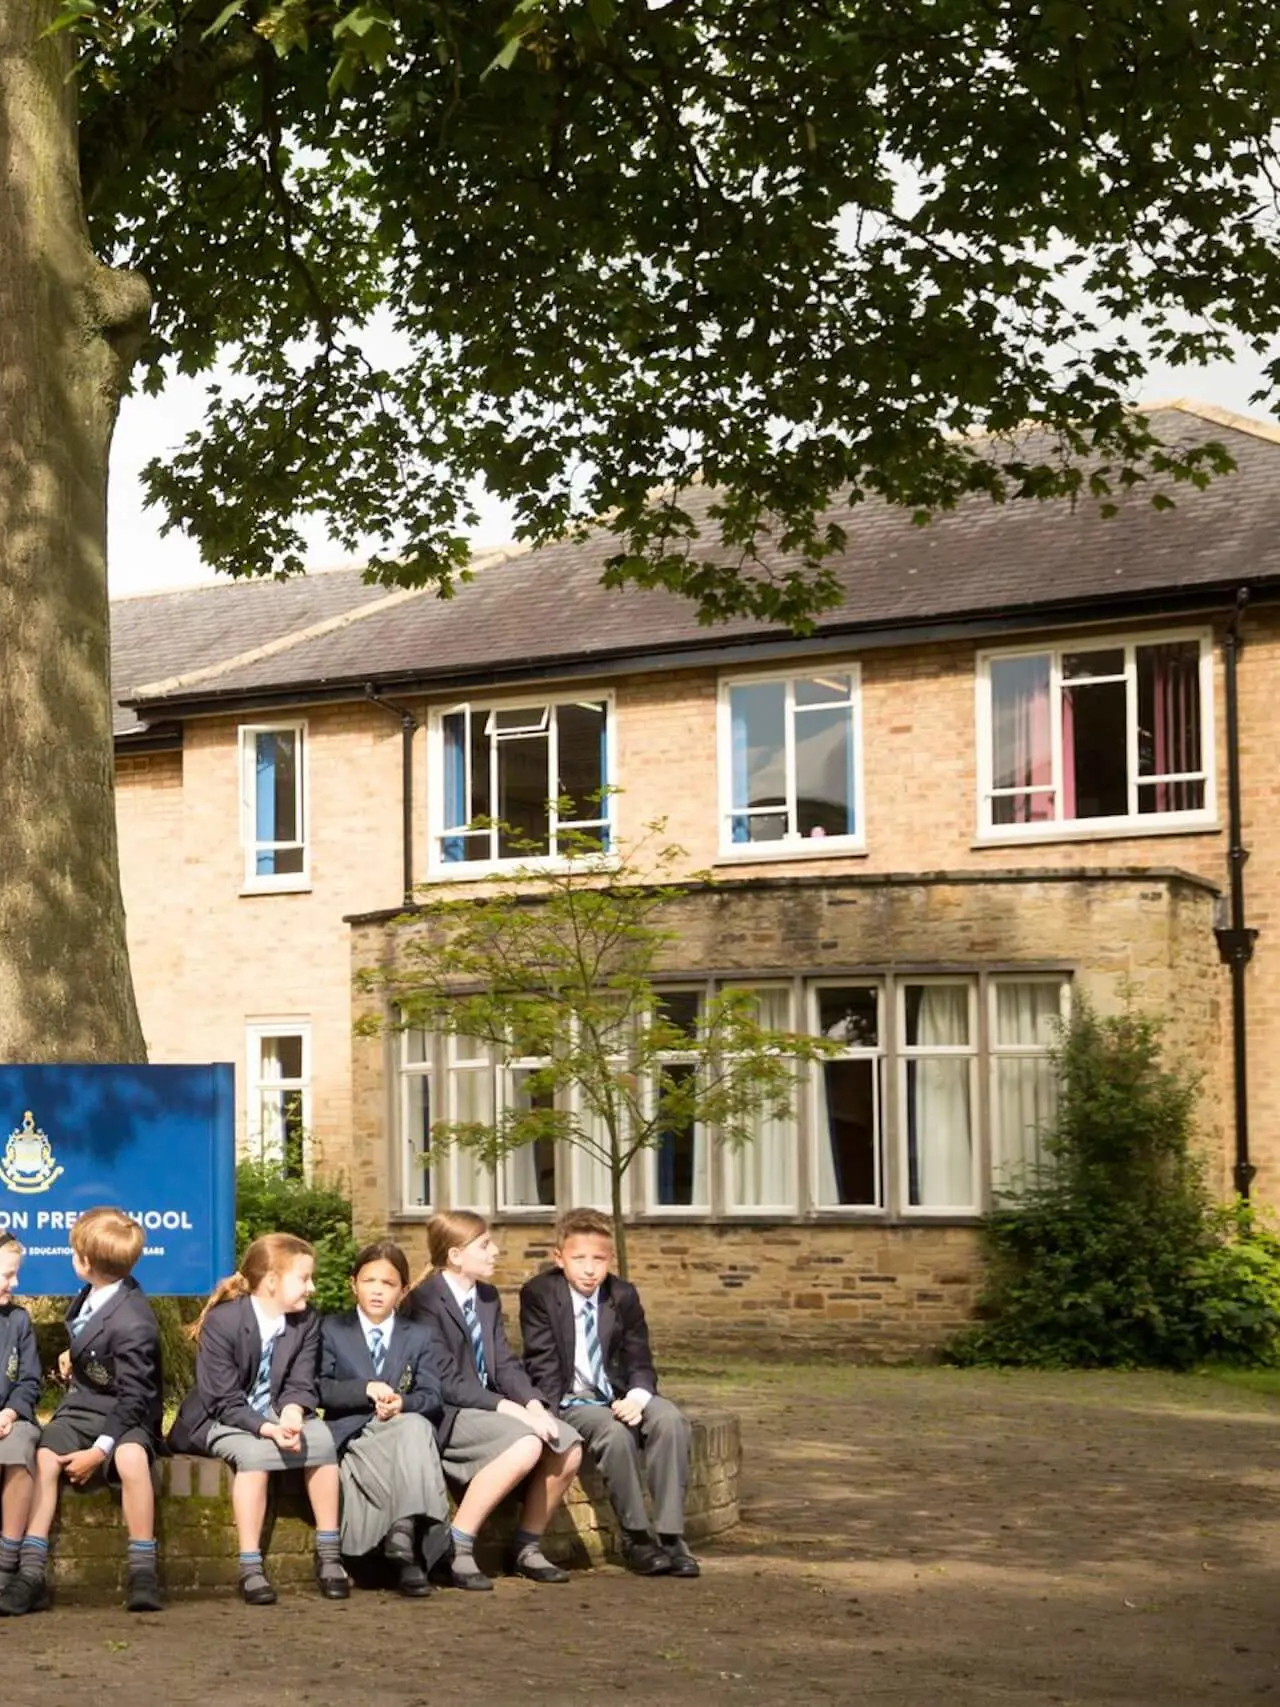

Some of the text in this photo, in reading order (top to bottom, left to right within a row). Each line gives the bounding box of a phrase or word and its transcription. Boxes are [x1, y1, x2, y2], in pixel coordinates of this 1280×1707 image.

[37, 1211, 84, 1229] PRE
[123, 1211, 193, 1230] HOOL
[142, 1246, 165, 1256] EARS
